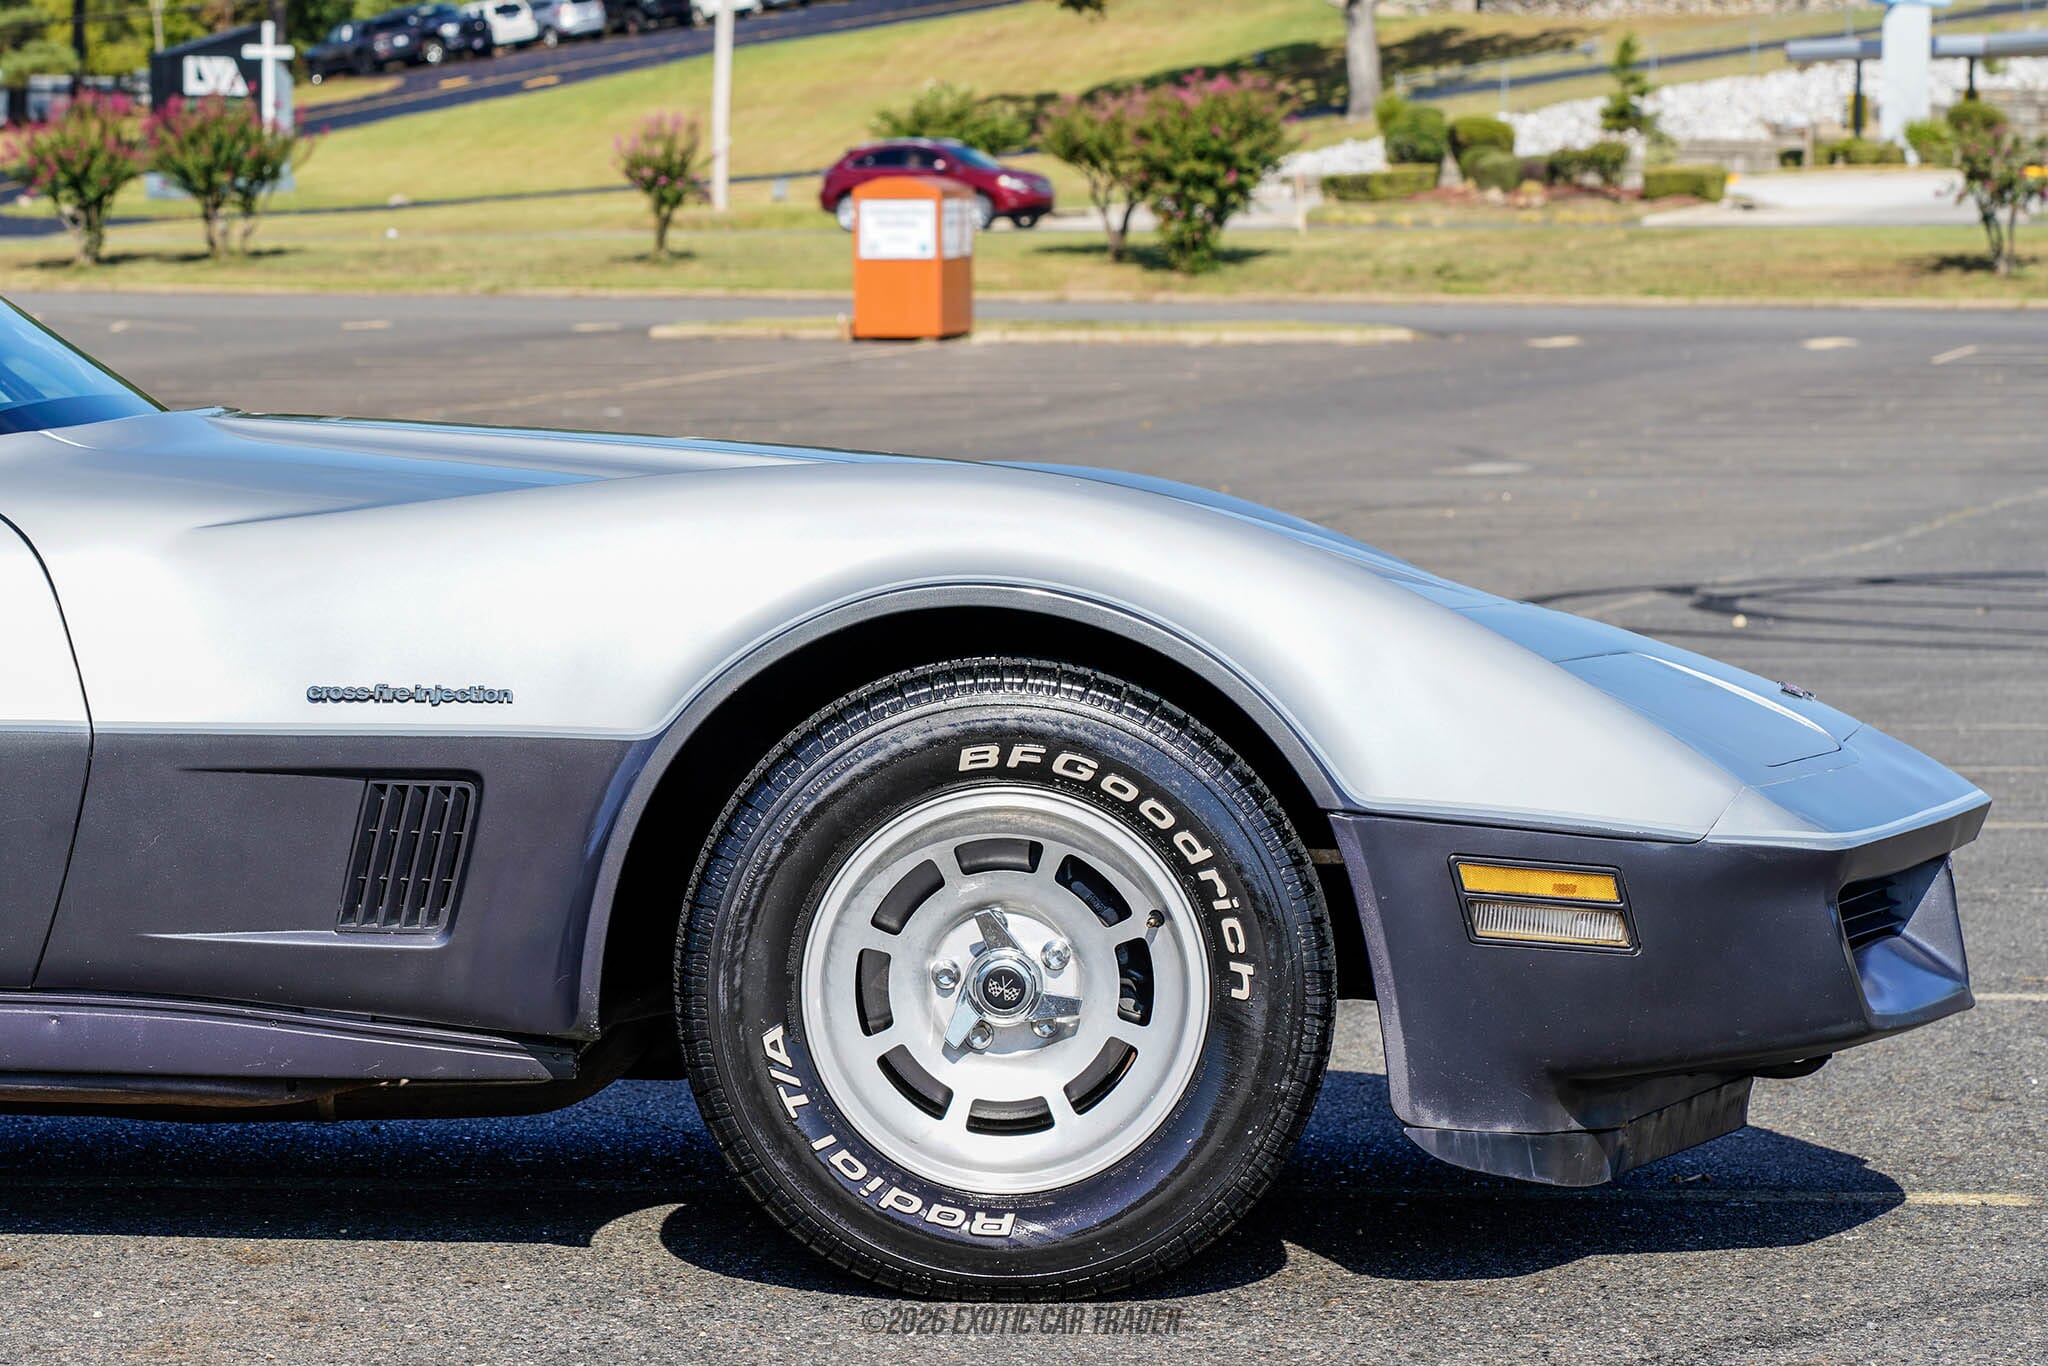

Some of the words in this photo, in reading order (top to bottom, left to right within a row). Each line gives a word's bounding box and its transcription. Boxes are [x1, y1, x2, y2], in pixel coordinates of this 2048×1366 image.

[958, 743, 1256, 1001] BFGoodrich
[762, 1025, 810, 1119] T/A
[811, 1134, 1016, 1237] Radial
